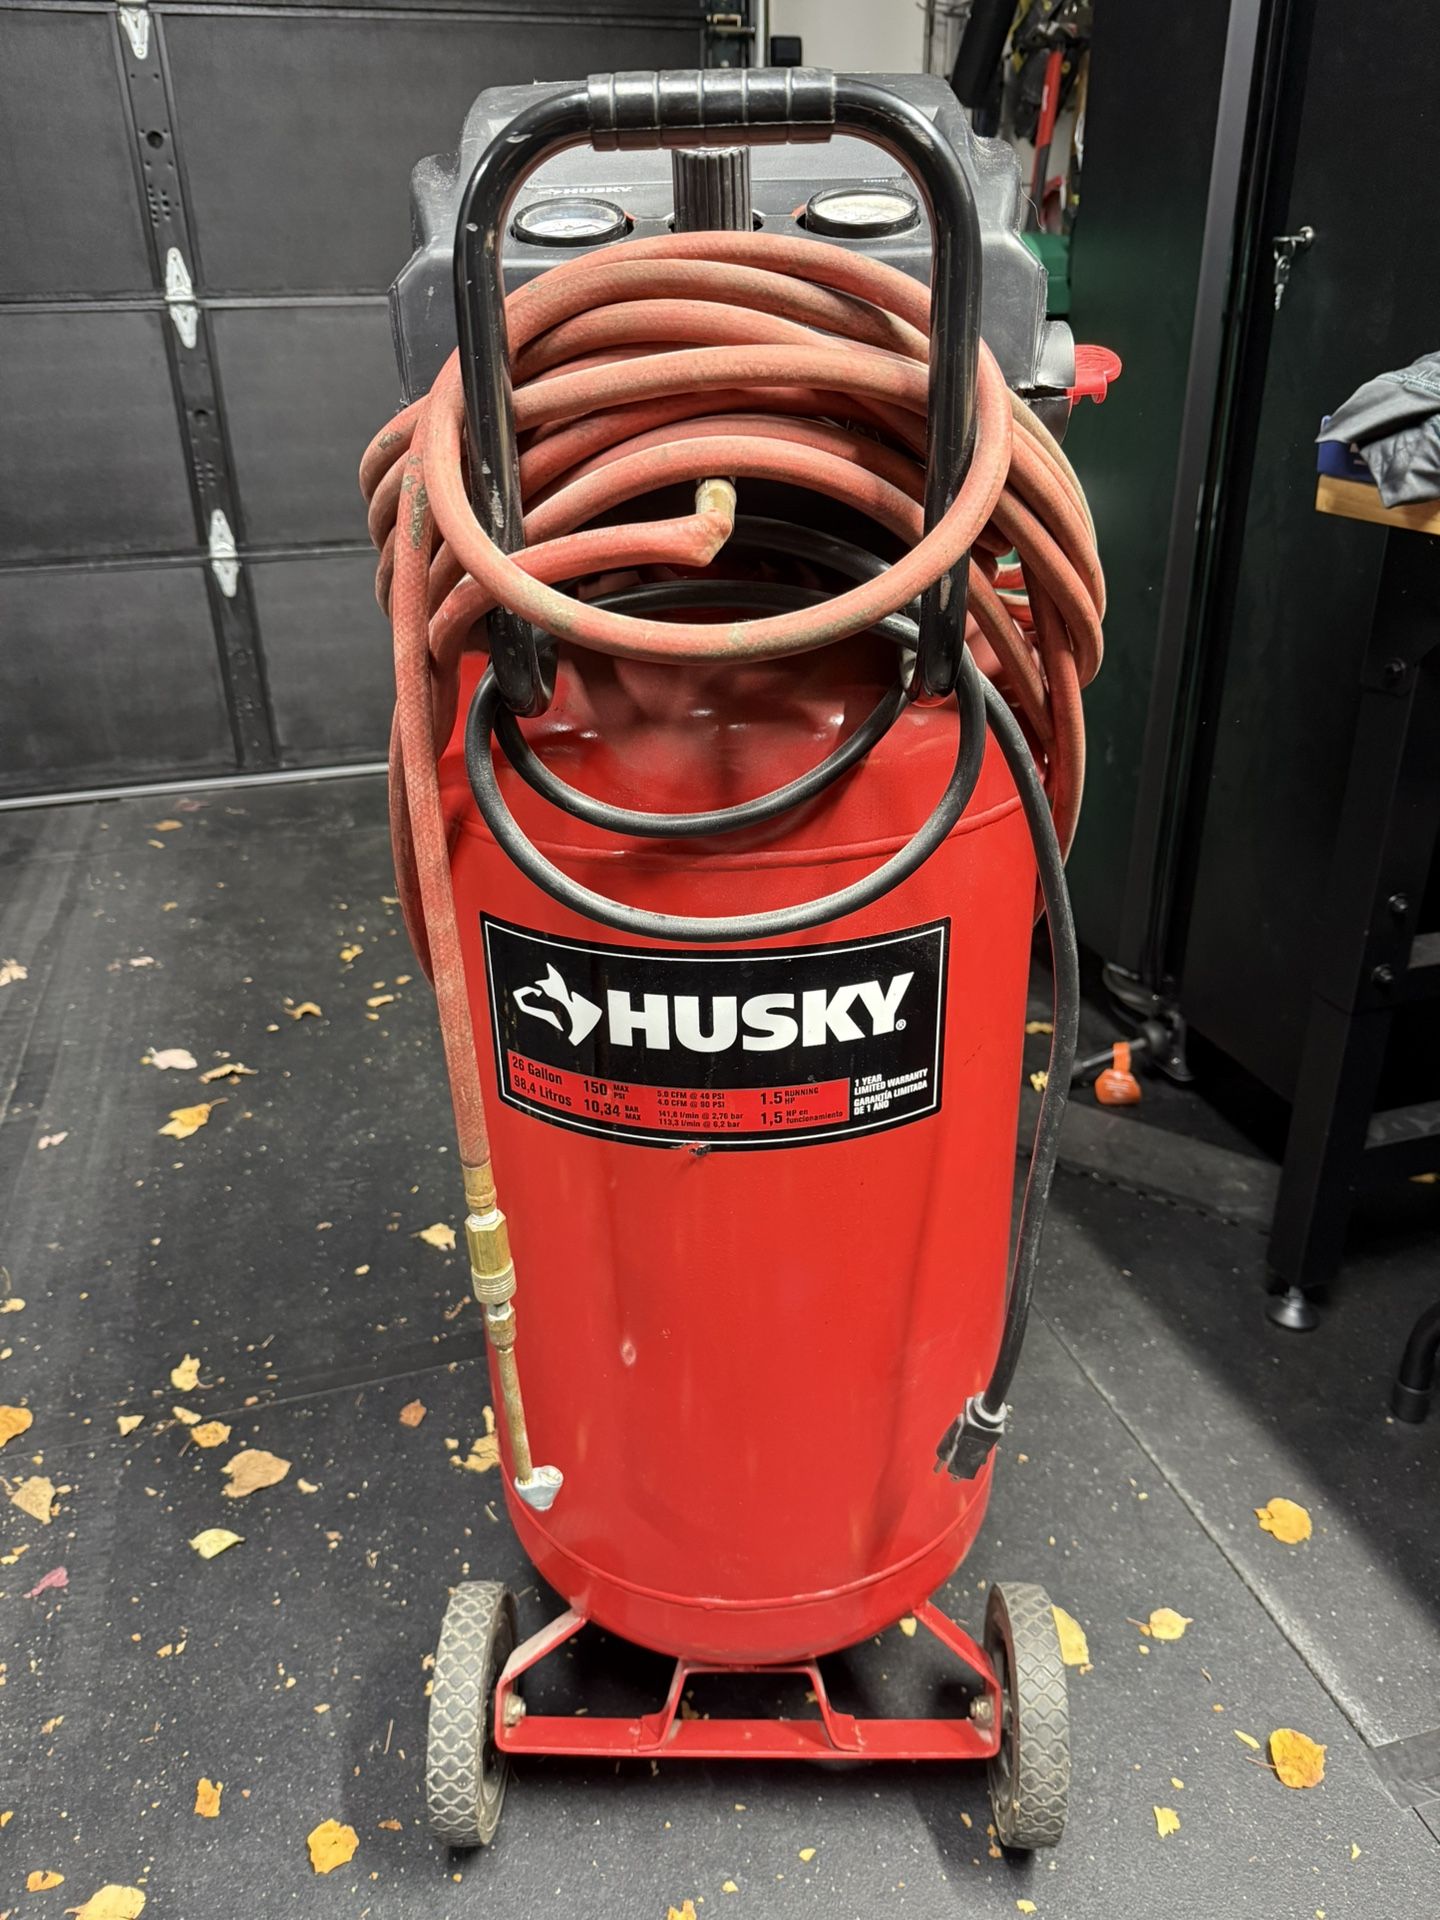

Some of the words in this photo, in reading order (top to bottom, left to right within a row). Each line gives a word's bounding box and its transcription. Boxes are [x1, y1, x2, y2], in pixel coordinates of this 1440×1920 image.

[564, 186, 633, 194] HUSKY
[607, 972, 914, 1053] HUSKY
[512, 1056, 525, 1072] 26
[528, 1062, 563, 1085] Gallon
[854, 1081, 886, 1095] LIMITED
[887, 1067, 928, 1088] WARRANTY
[855, 1079, 859, 1087] 1
[862, 1073, 882, 1085] YEAR
[513, 1075, 536, 1095] 98,4
[540, 1085, 572, 1107] Litros
[584, 1080, 608, 1096] 150
[614, 1084, 629, 1093] MAX
[657, 1090, 669, 1098] 5.0
[671, 1091, 687, 1099] CFM
[785, 1087, 819, 1097] RUNNING
[854, 1090, 892, 1107] GARANTÍA
[894, 1080, 927, 1097] LIMITADA
[614, 1092, 625, 1100] PSI
[761, 1092, 782, 1105] 1.5
[585, 1099, 620, 1117] 10,34
[671, 1099, 687, 1107] CFM
[854, 1106, 864, 1115] DE
[866, 1104, 870, 1112] 1
[625, 1113, 641, 1121] MAX
[659, 1118, 679, 1127] 113,3
[761, 1112, 782, 1127] 1,5
[787, 1111, 843, 1124] funcionamiento
